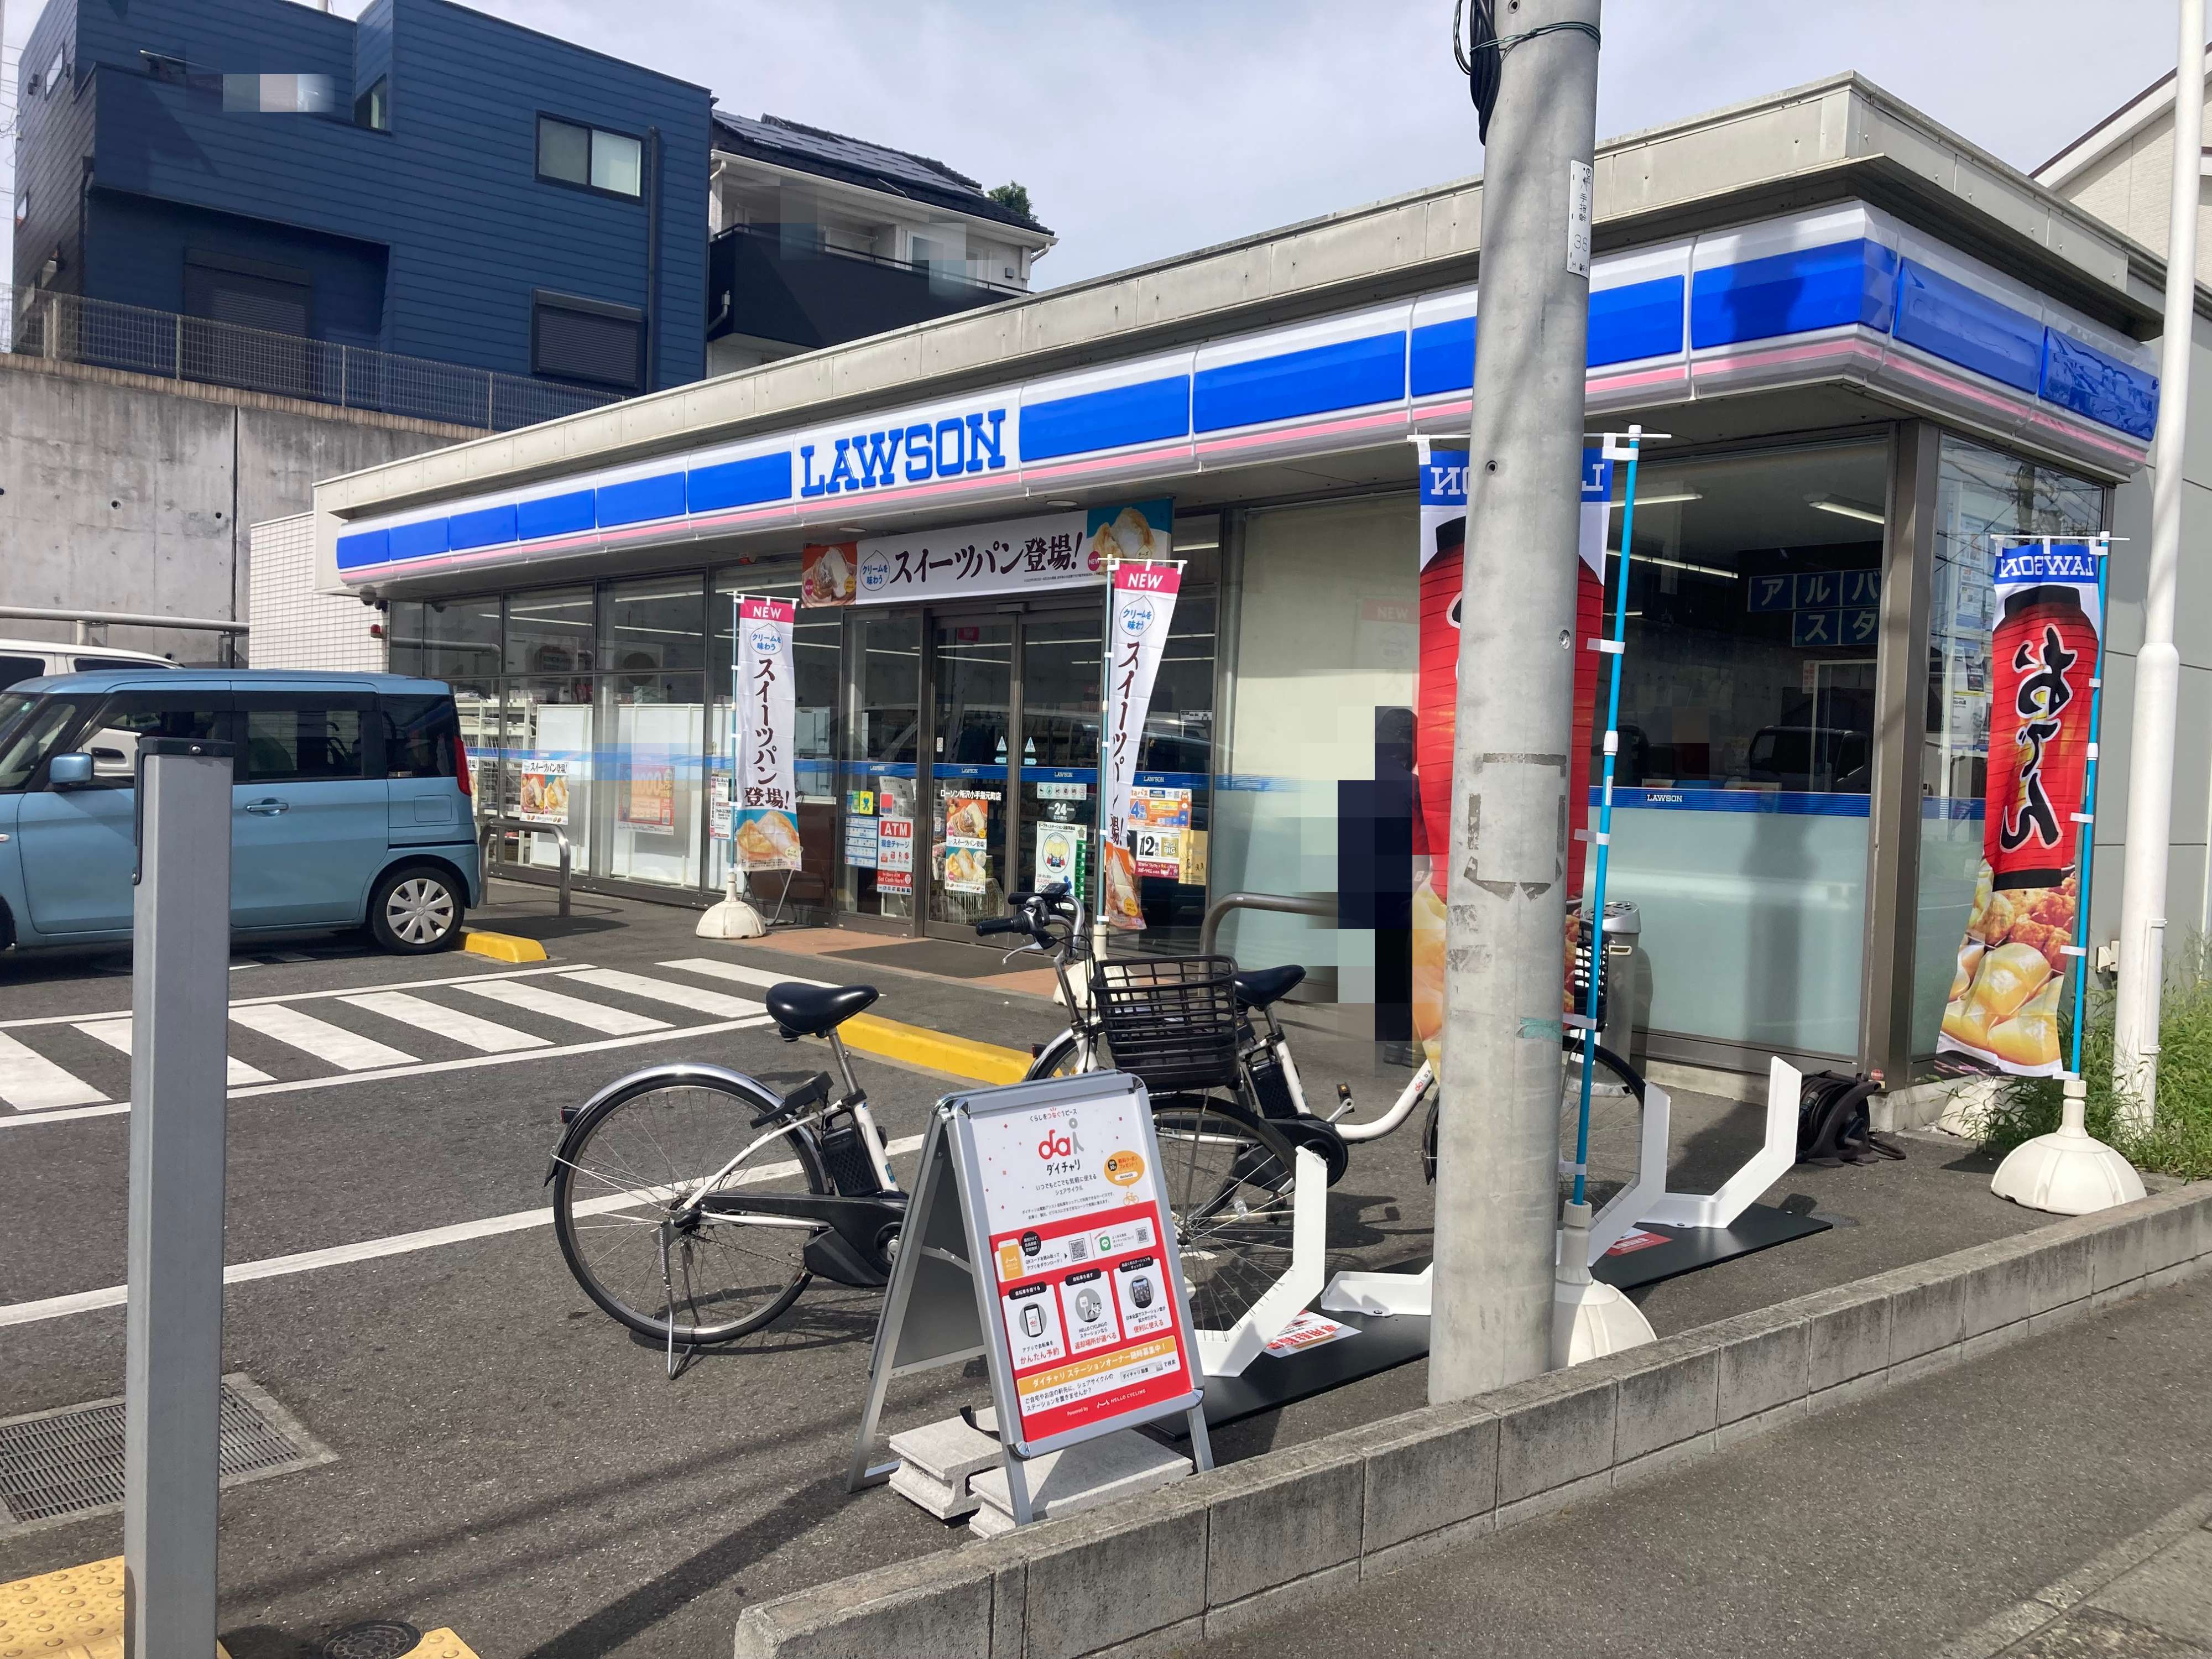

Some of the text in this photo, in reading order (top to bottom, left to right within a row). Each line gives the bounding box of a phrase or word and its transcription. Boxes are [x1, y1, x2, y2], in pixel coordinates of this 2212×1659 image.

[800, 409, 1006, 497] LAWSON
[889, 531, 1083, 583] スイーツパン登場!
[862, 562, 888, 575] クリームを
[867, 575, 883, 585] 味わう
[1128, 573, 1163, 589] NEW
[753, 606, 781, 619] NEW
[1123, 608, 1151, 620] クリームを
[1127, 619, 1145, 631] 味わう
[1804, 611, 1877, 641] スタ
[752, 633, 781, 643] クリームを
[757, 641, 776, 651] 味わう
[753, 658, 777, 786] スイーツパン
[744, 786, 790, 810] 登場!
[941, 789, 1001, 801] ローソン所沢小手指元町店
[1646, 794, 1683, 802] LAWSON
[1055, 802, 1067, 815] 24
[885, 822, 907, 836] ATM
[881, 839, 910, 848] 現金チャージ
[1139, 836, 1155, 856] 12
[1030, 1108, 1077, 1122] くらしをつなぐ1ピース
[1046, 1159, 1081, 1176] ダイチャリ
[1036, 1173, 1097, 1191] いつでもどこでも気軽に使える
[1055, 1185, 1083, 1196] シェアサイクル
[1025, 1253, 1060, 1265] QRコードを読み取って
[1134, 1319, 1164, 1333] 便利に使える
[1022, 1340, 1053, 1353] アプリで自転車を
[1020, 1347, 1060, 1365] かんたん予約
[1032, 1371, 1065, 1387] ダイチャリ
[1110, 1389, 1146, 1404] HELLO CYCLING
[1067, 1406, 1083, 1417] Powered
